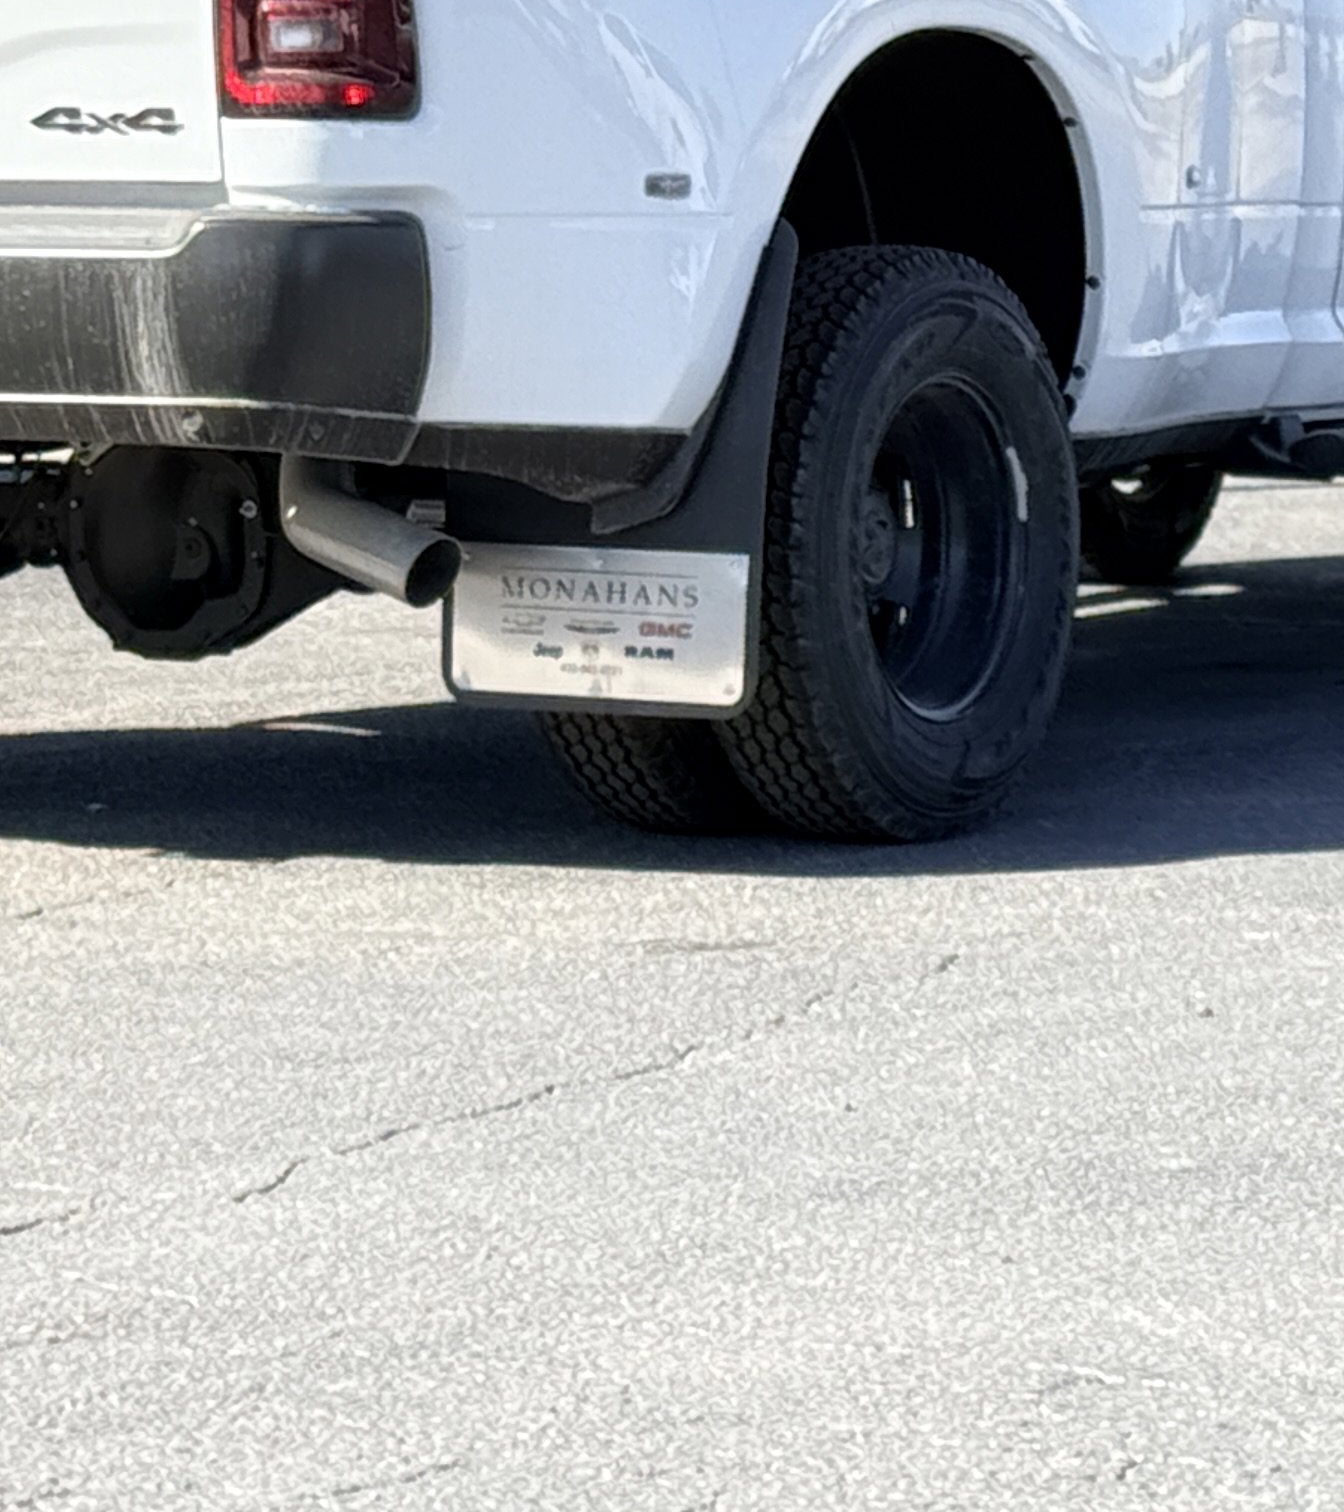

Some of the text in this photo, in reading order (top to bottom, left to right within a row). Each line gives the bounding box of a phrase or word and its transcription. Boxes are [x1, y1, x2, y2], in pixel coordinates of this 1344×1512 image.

[29, 106, 185, 136] 4x4
[501, 575, 700, 609] MONAHANS
[638, 620, 694, 640] GMC
[623, 645, 675, 661] RAM
